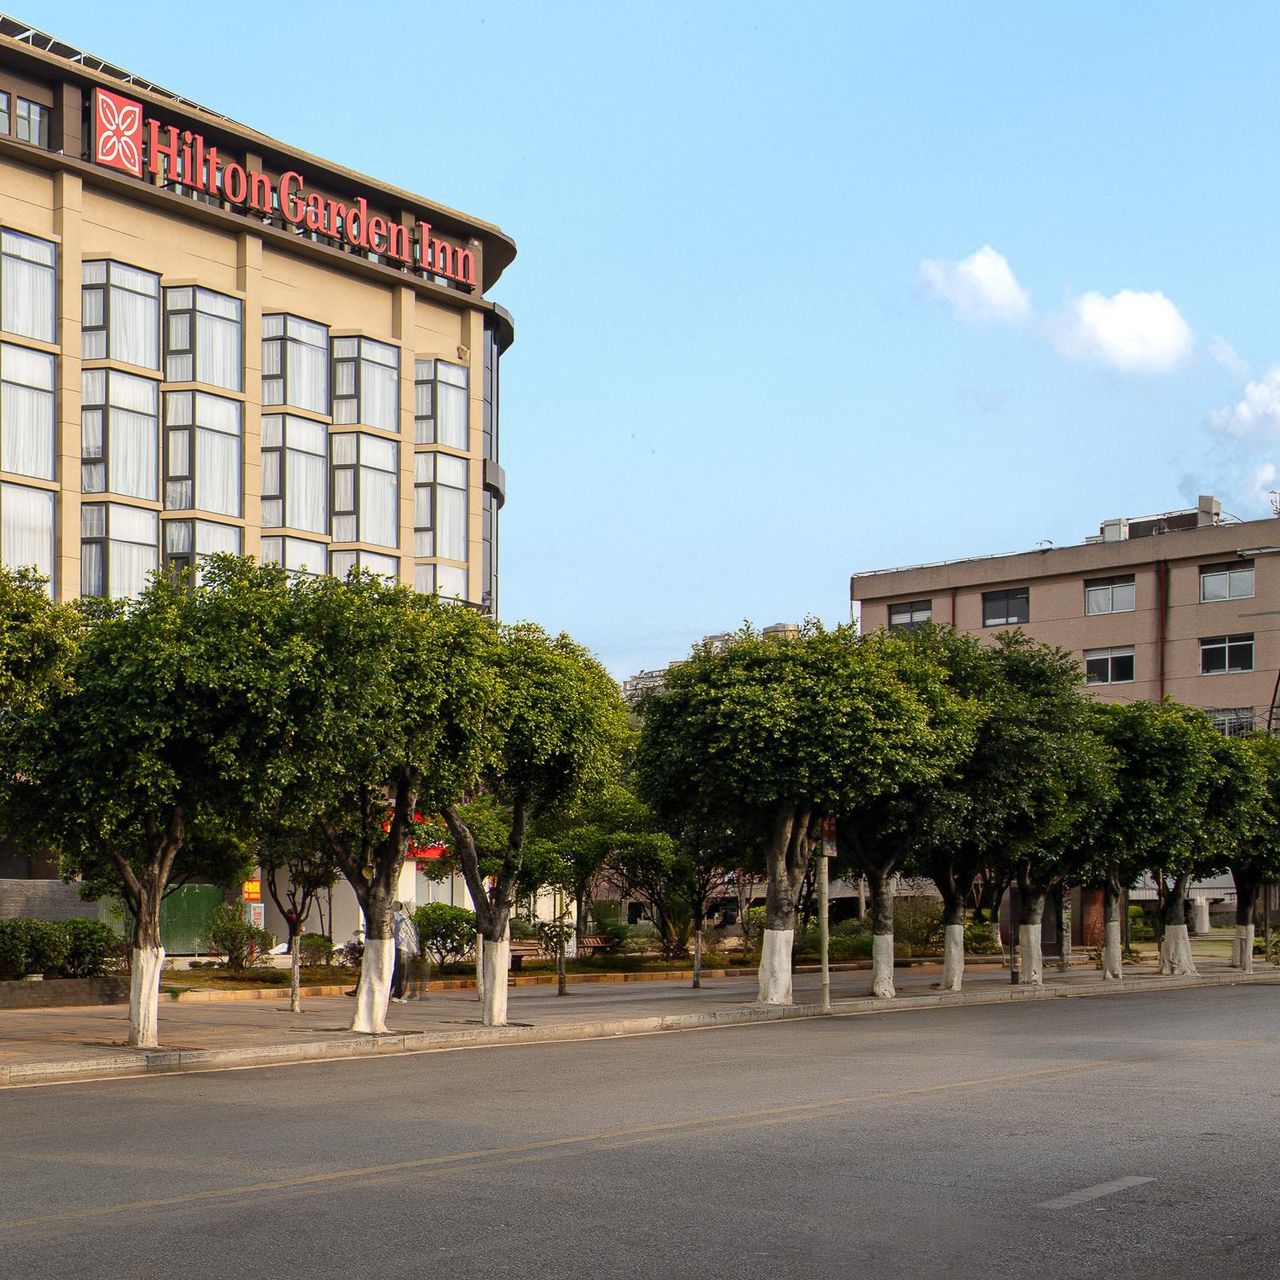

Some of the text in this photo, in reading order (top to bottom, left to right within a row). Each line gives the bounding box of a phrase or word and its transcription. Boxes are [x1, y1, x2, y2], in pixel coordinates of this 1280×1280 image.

[147, 117, 478, 287] Hilton Garden Inn
